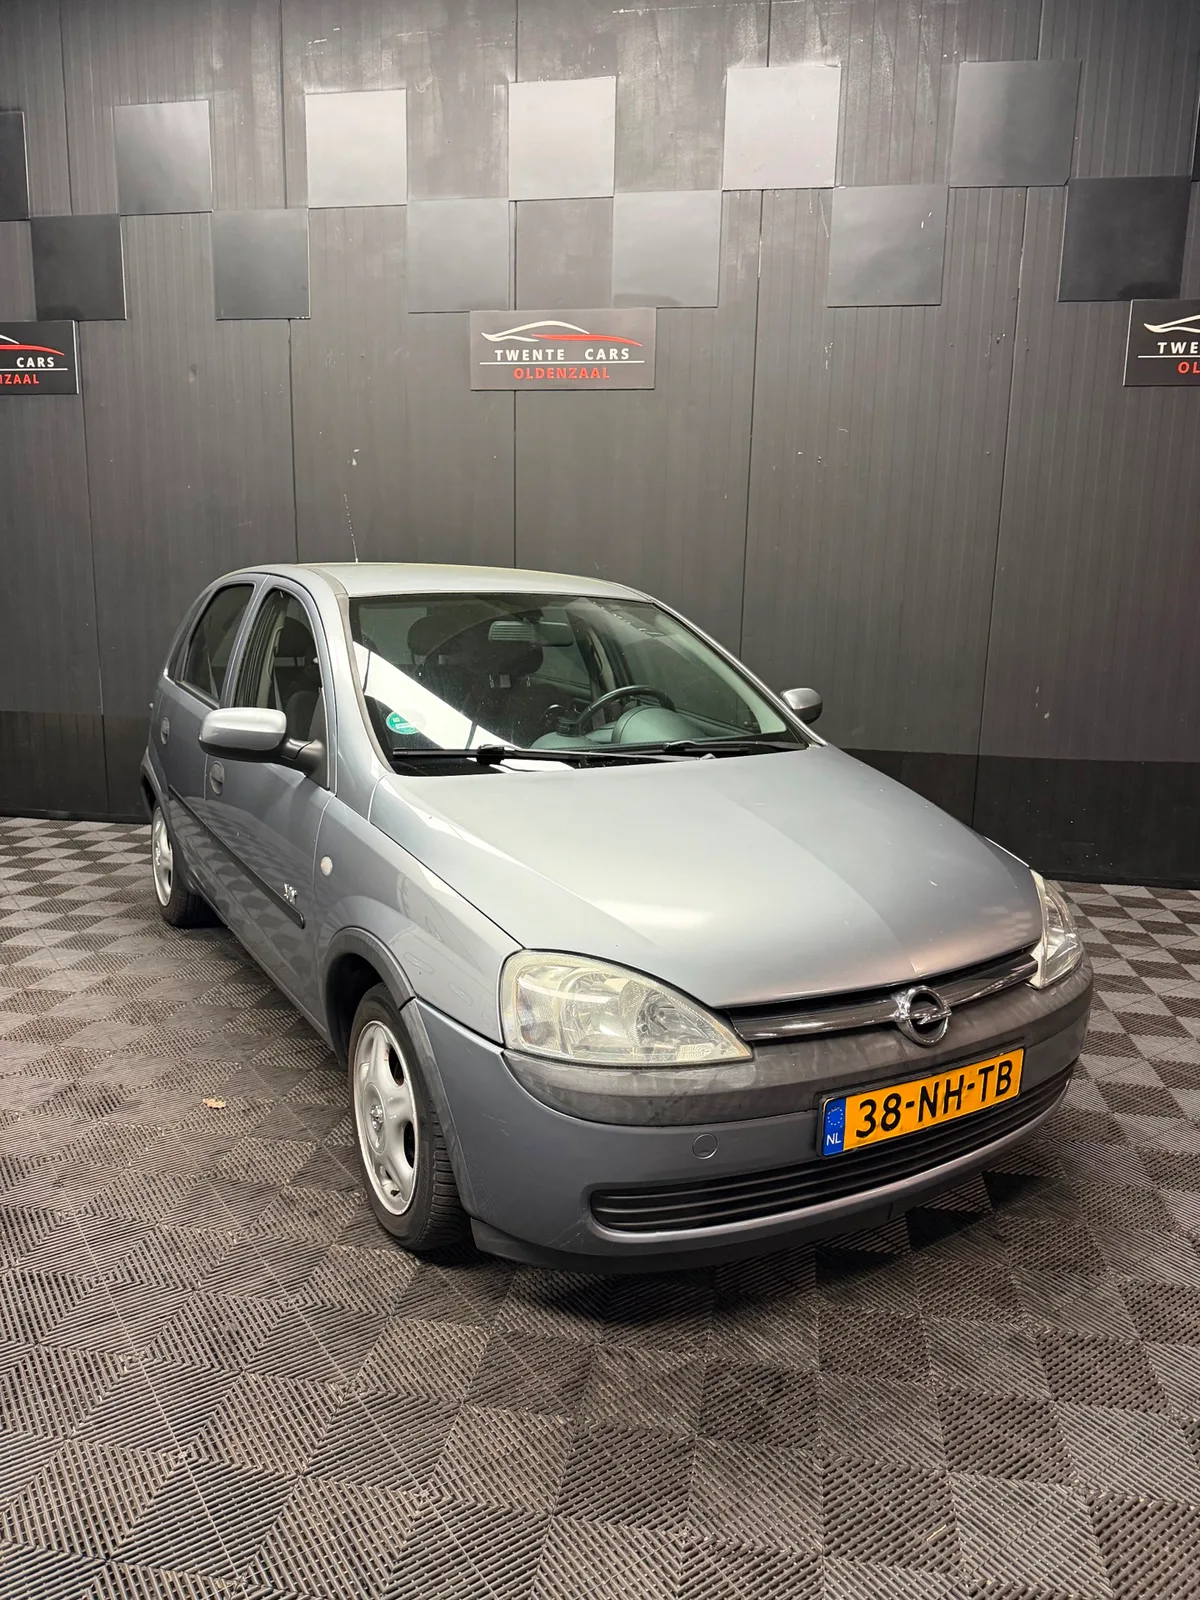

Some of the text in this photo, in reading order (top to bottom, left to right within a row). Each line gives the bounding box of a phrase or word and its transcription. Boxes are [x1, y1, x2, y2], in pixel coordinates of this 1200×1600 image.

[494, 347, 630, 362] TWENTE CARS
[16, 356, 55, 368] CARS
[513, 366, 610, 380] OLDENZAAL
[855, 1059, 1013, 1139] 38-NH-TB
[825, 1132, 842, 1146] NL
